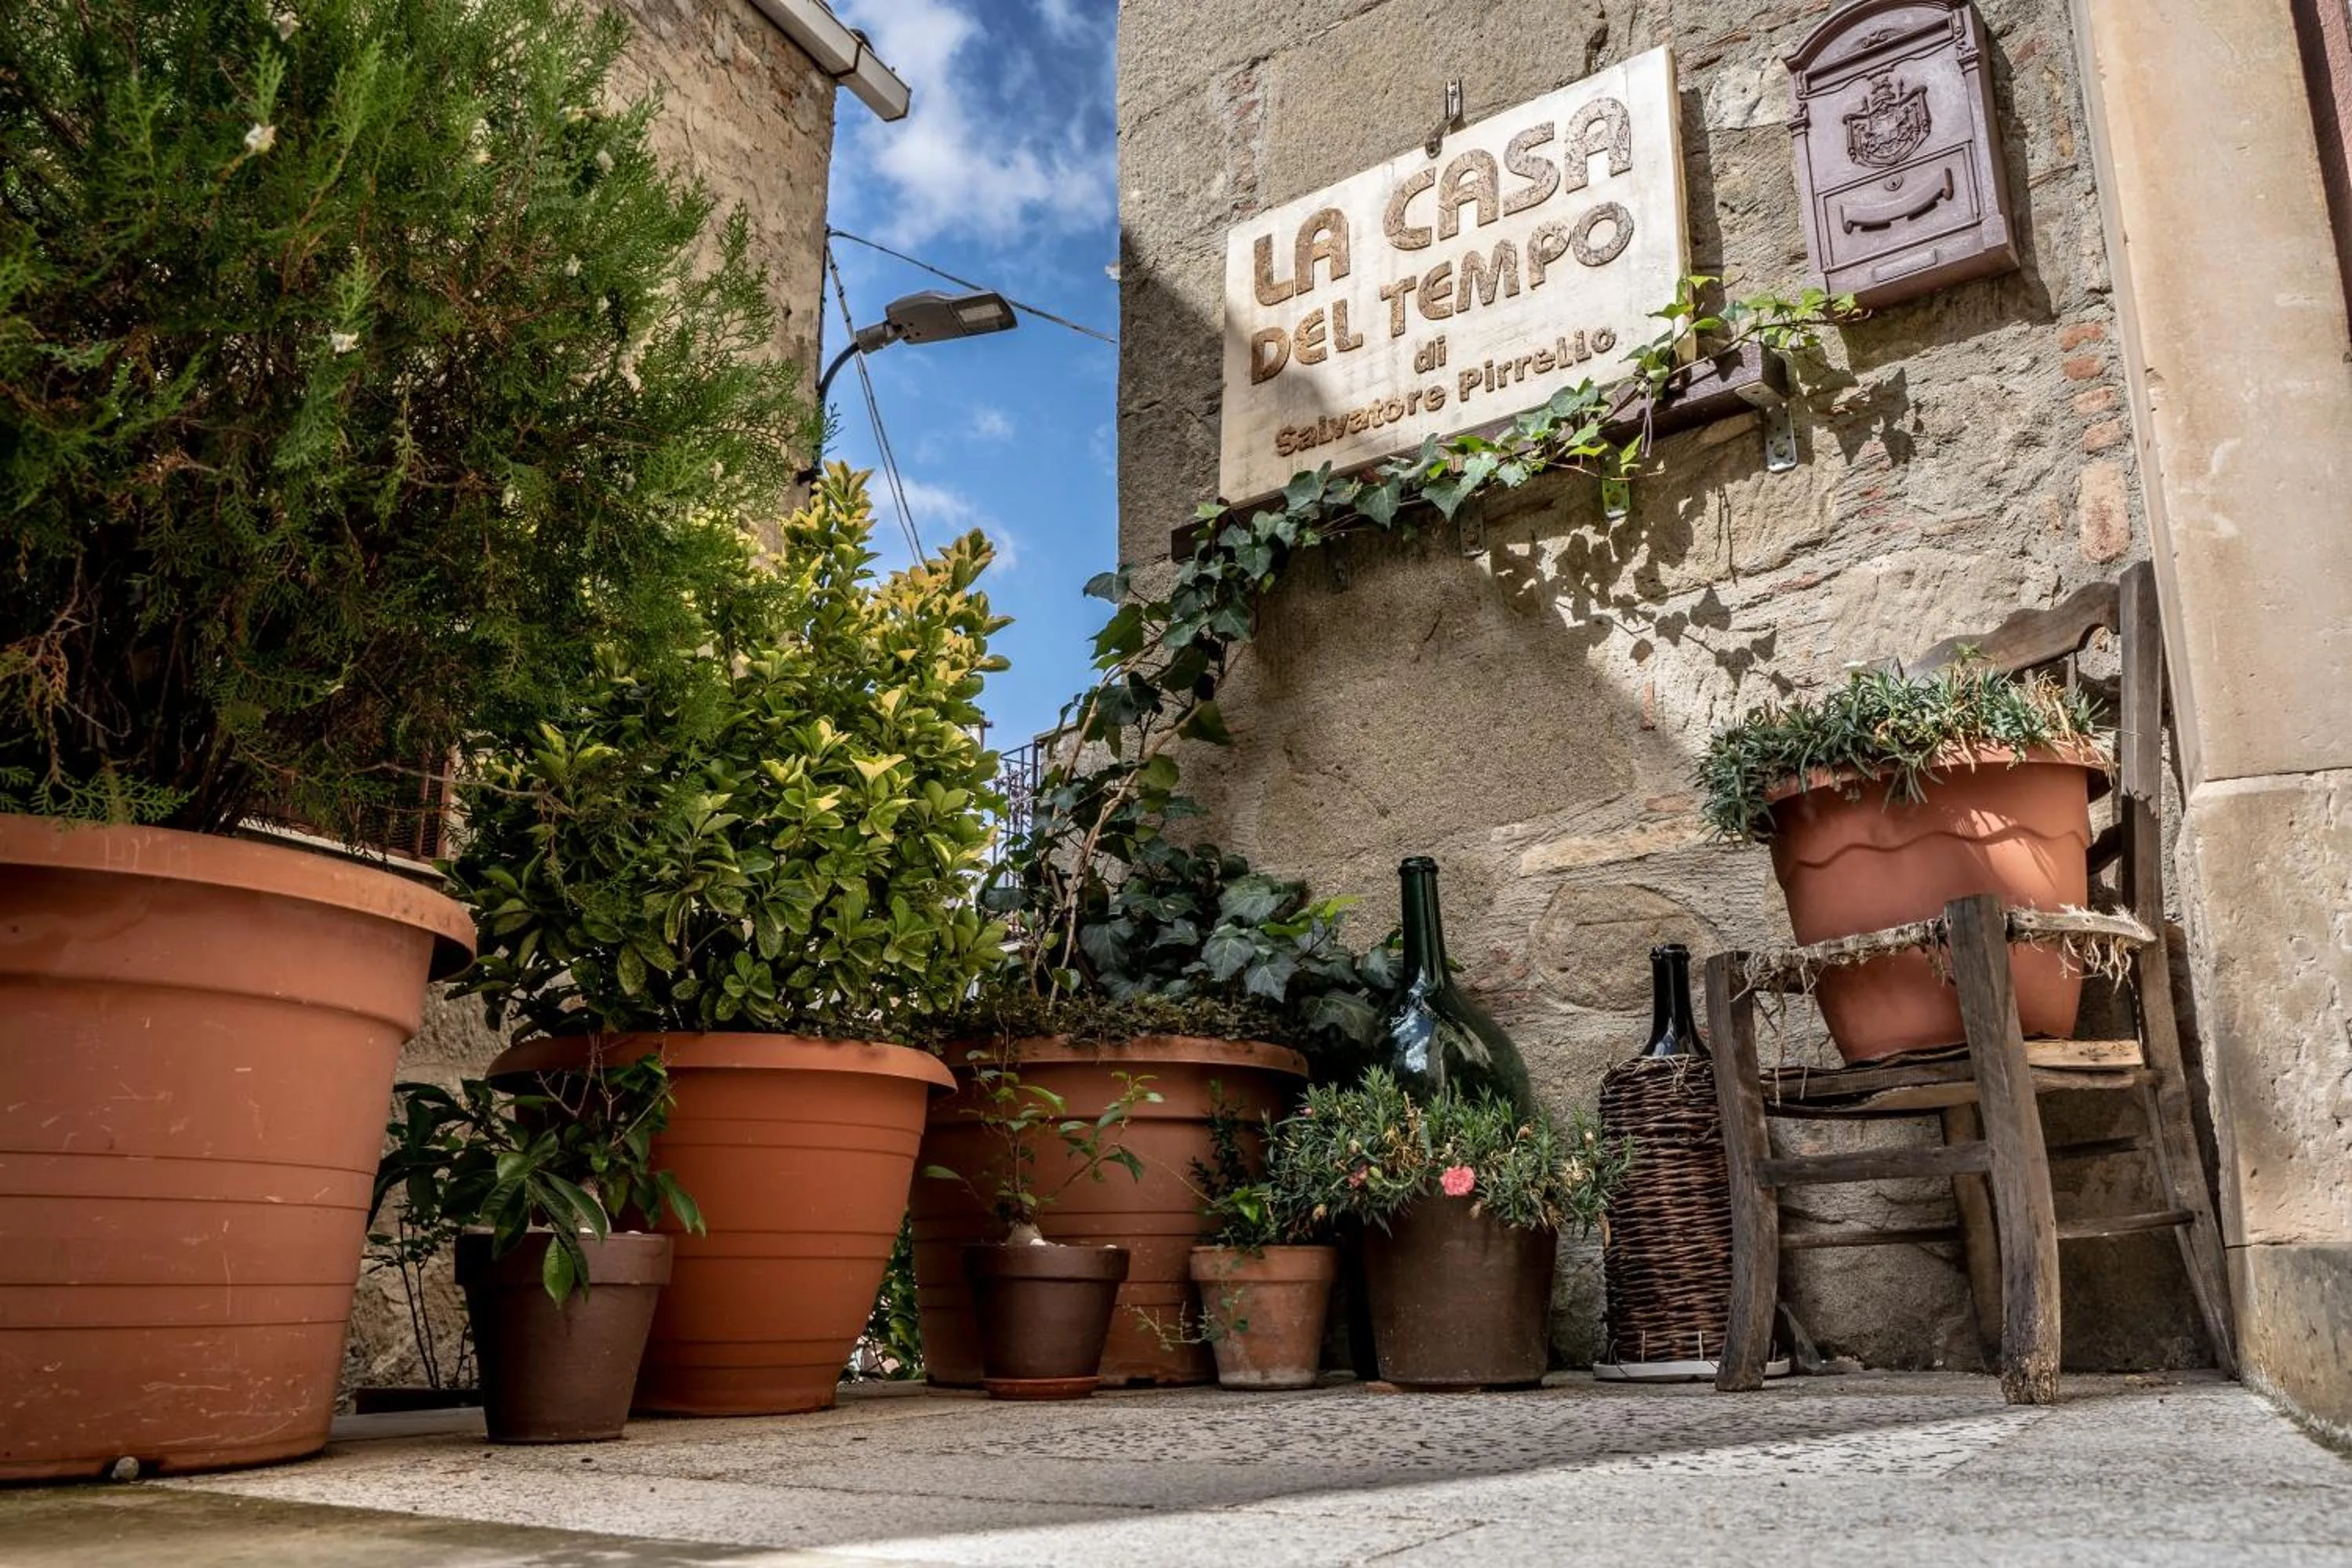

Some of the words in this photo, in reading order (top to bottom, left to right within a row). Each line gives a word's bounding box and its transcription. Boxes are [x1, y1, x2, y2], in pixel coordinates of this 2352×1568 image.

[1254, 207, 1351, 307] LA
[1383, 96, 1632, 251] CASA
[1251, 299, 1363, 386] DEL
[1380, 201, 1635, 338] TEMPO
[1414, 334, 1447, 374] di
[1276, 385, 1446, 457] Salvatore
[1458, 326, 1617, 402] Pirrello
